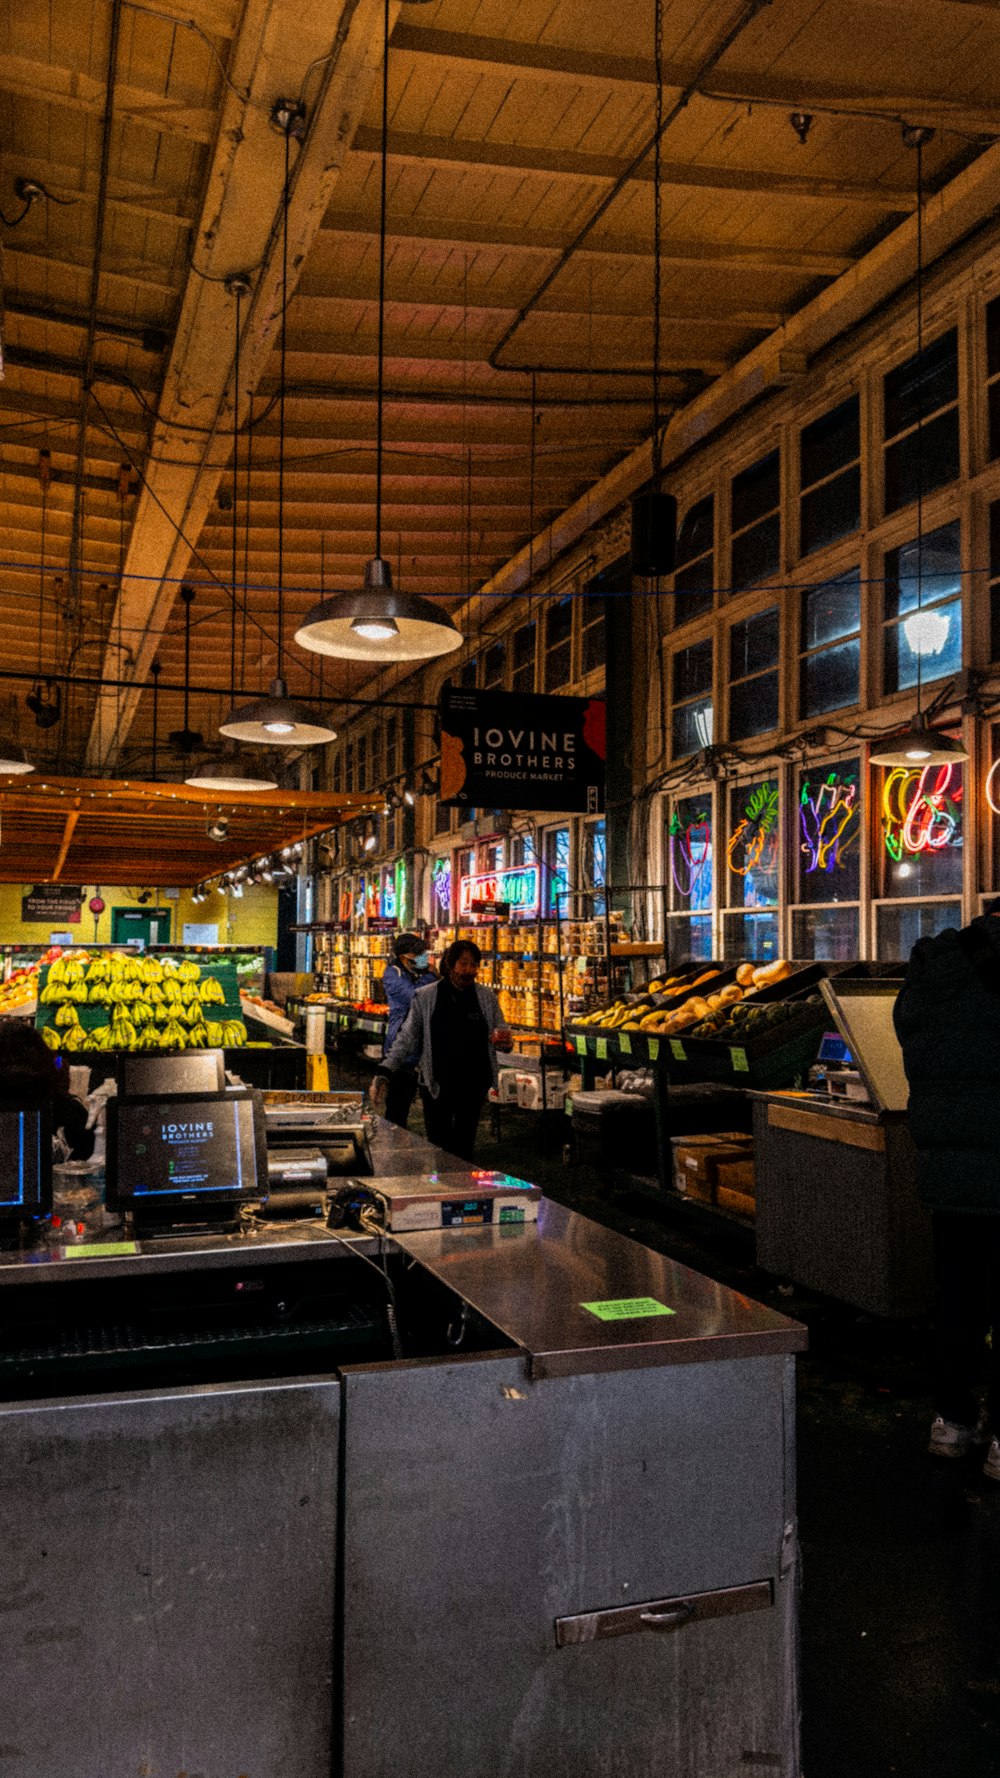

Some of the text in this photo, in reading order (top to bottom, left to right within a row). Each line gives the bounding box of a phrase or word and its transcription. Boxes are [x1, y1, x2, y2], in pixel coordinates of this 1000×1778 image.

[473, 728, 575, 752] IOVINE
[473, 752, 575, 769] BROTHERS
[485, 770, 563, 781] PRODUCE MARKET
[161, 1122, 213, 1133] IOVINE
[161, 1132, 214, 1140] BROTHERS
